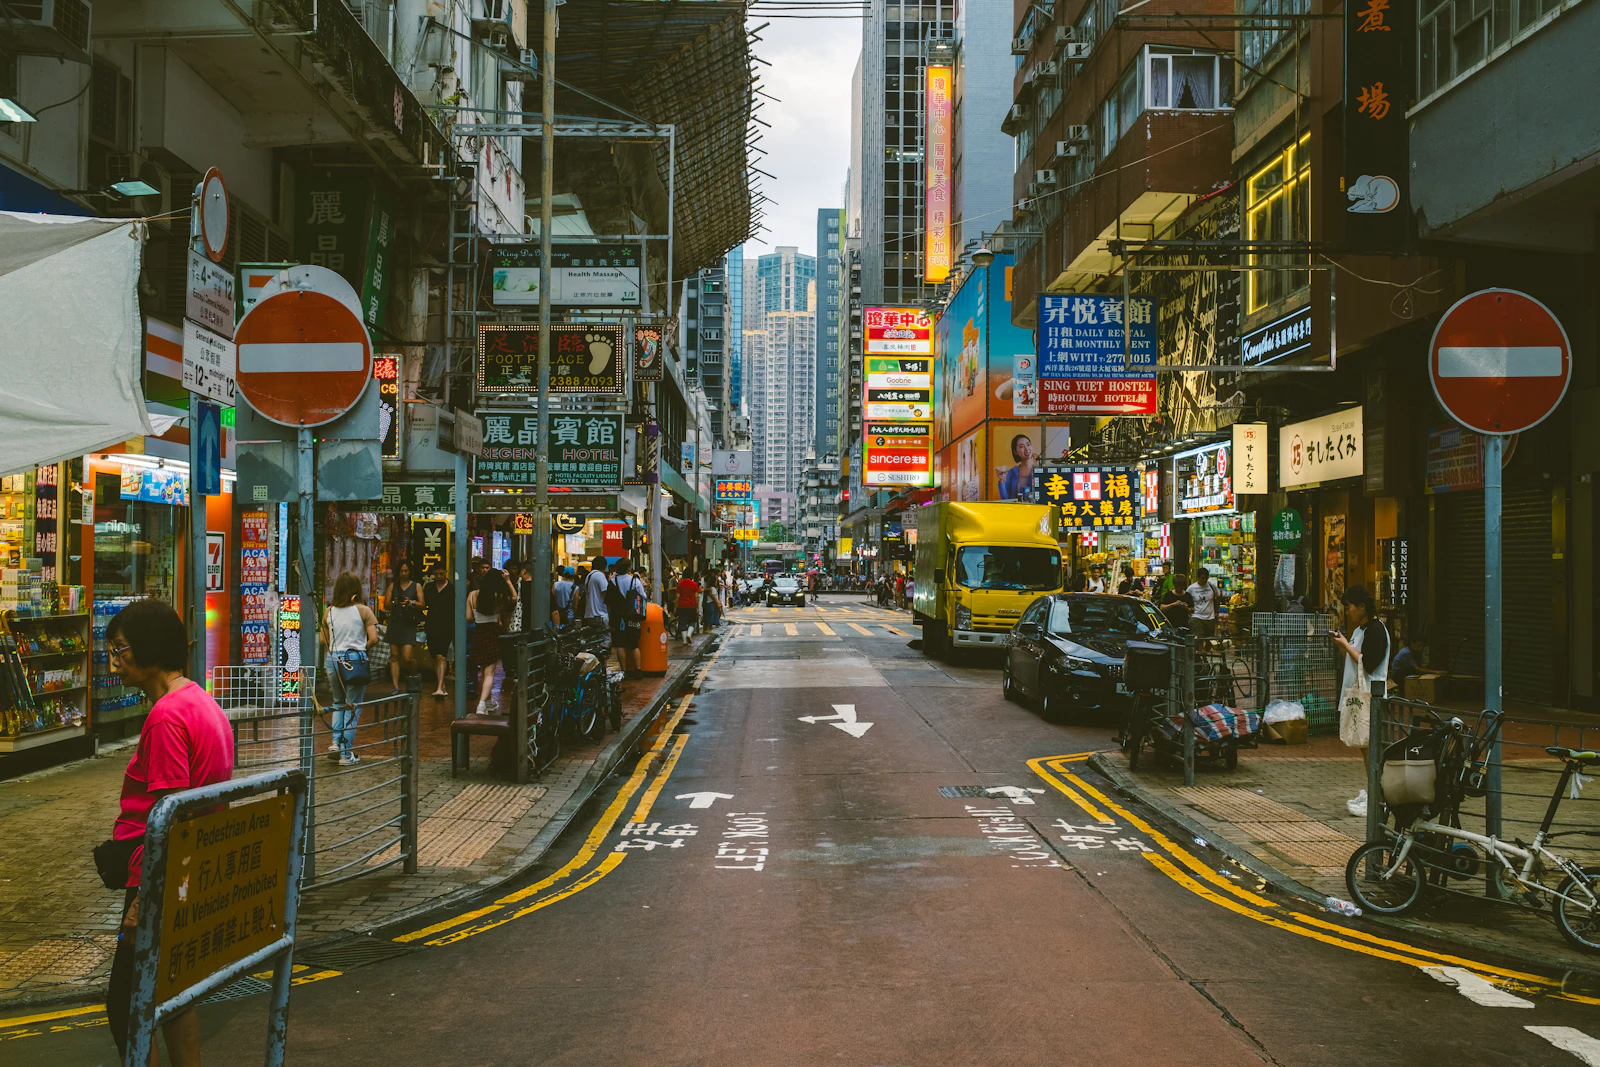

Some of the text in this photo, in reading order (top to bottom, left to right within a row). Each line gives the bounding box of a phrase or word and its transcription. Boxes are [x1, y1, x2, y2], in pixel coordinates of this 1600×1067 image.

[224, 279, 233, 300] 12
[867, 311, 932, 328] 瓊華中心
[1048, 327, 1074, 338] 日租
[1075, 329, 1104, 338] DAILY
[1047, 338, 1074, 349] 月租
[1075, 340, 1151, 349] MONTHLY ENT
[487, 355, 523, 365] FOOT
[1048, 351, 1069, 363] 上網
[1070, 353, 1098, 363] WITI
[583, 376, 614, 386] 2093
[1044, 380, 1153, 391] SING YUET HOSTEL
[226, 376, 235, 398] 12
[482, 447, 618, 461] REGEN HOTEL
[1307, 434, 1357, 466] すしたくみ
[1246, 444, 1254, 488] すしたくみ
[244, 587, 265, 595] ACA
[244, 625, 266, 633] ACA
[196, 812, 271, 849] Pedestrian Area
[198, 840, 264, 893] 行人專用區
[172, 868, 278, 933] All Vehicles Prohibited
